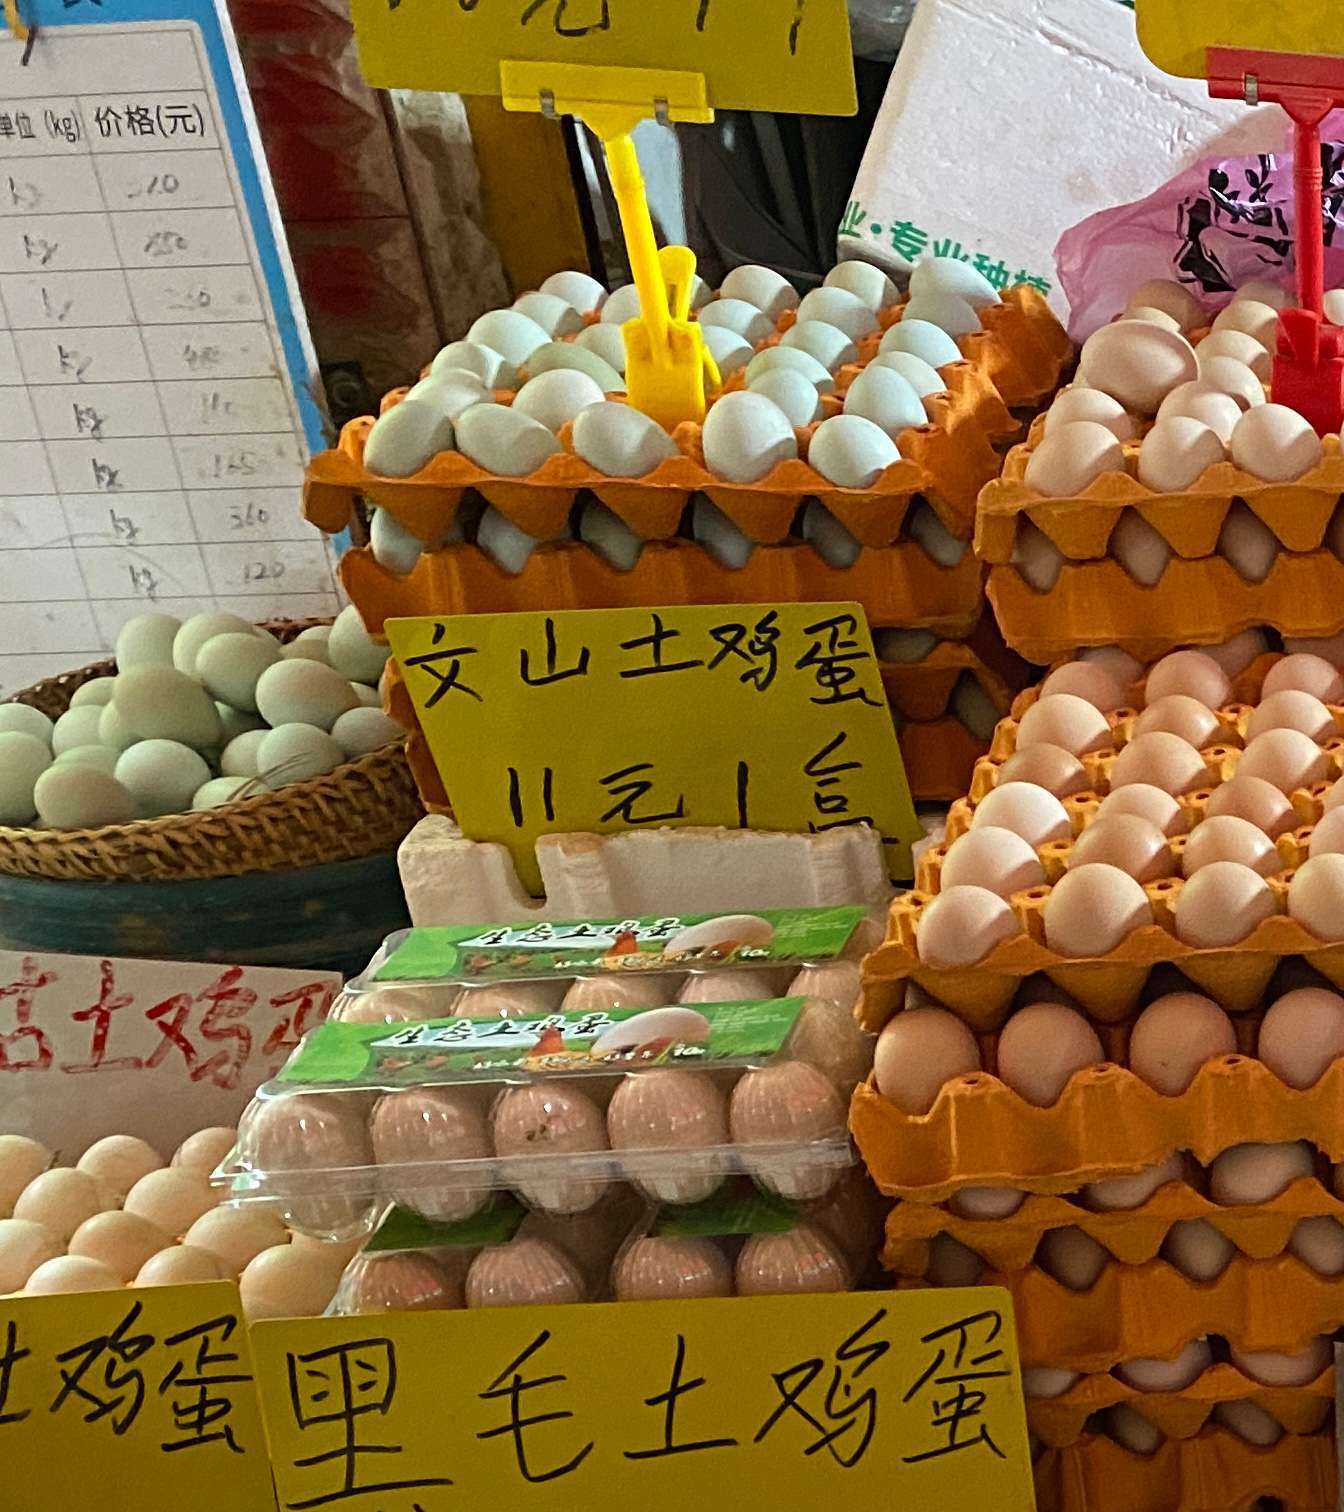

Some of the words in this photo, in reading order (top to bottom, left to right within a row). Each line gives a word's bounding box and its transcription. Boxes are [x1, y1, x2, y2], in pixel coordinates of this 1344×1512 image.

[44, 110, 80, 142] (kg)
[95, 104, 205, 138] 价格(元)
[405, 611, 884, 708] 文山土鸡蛋
